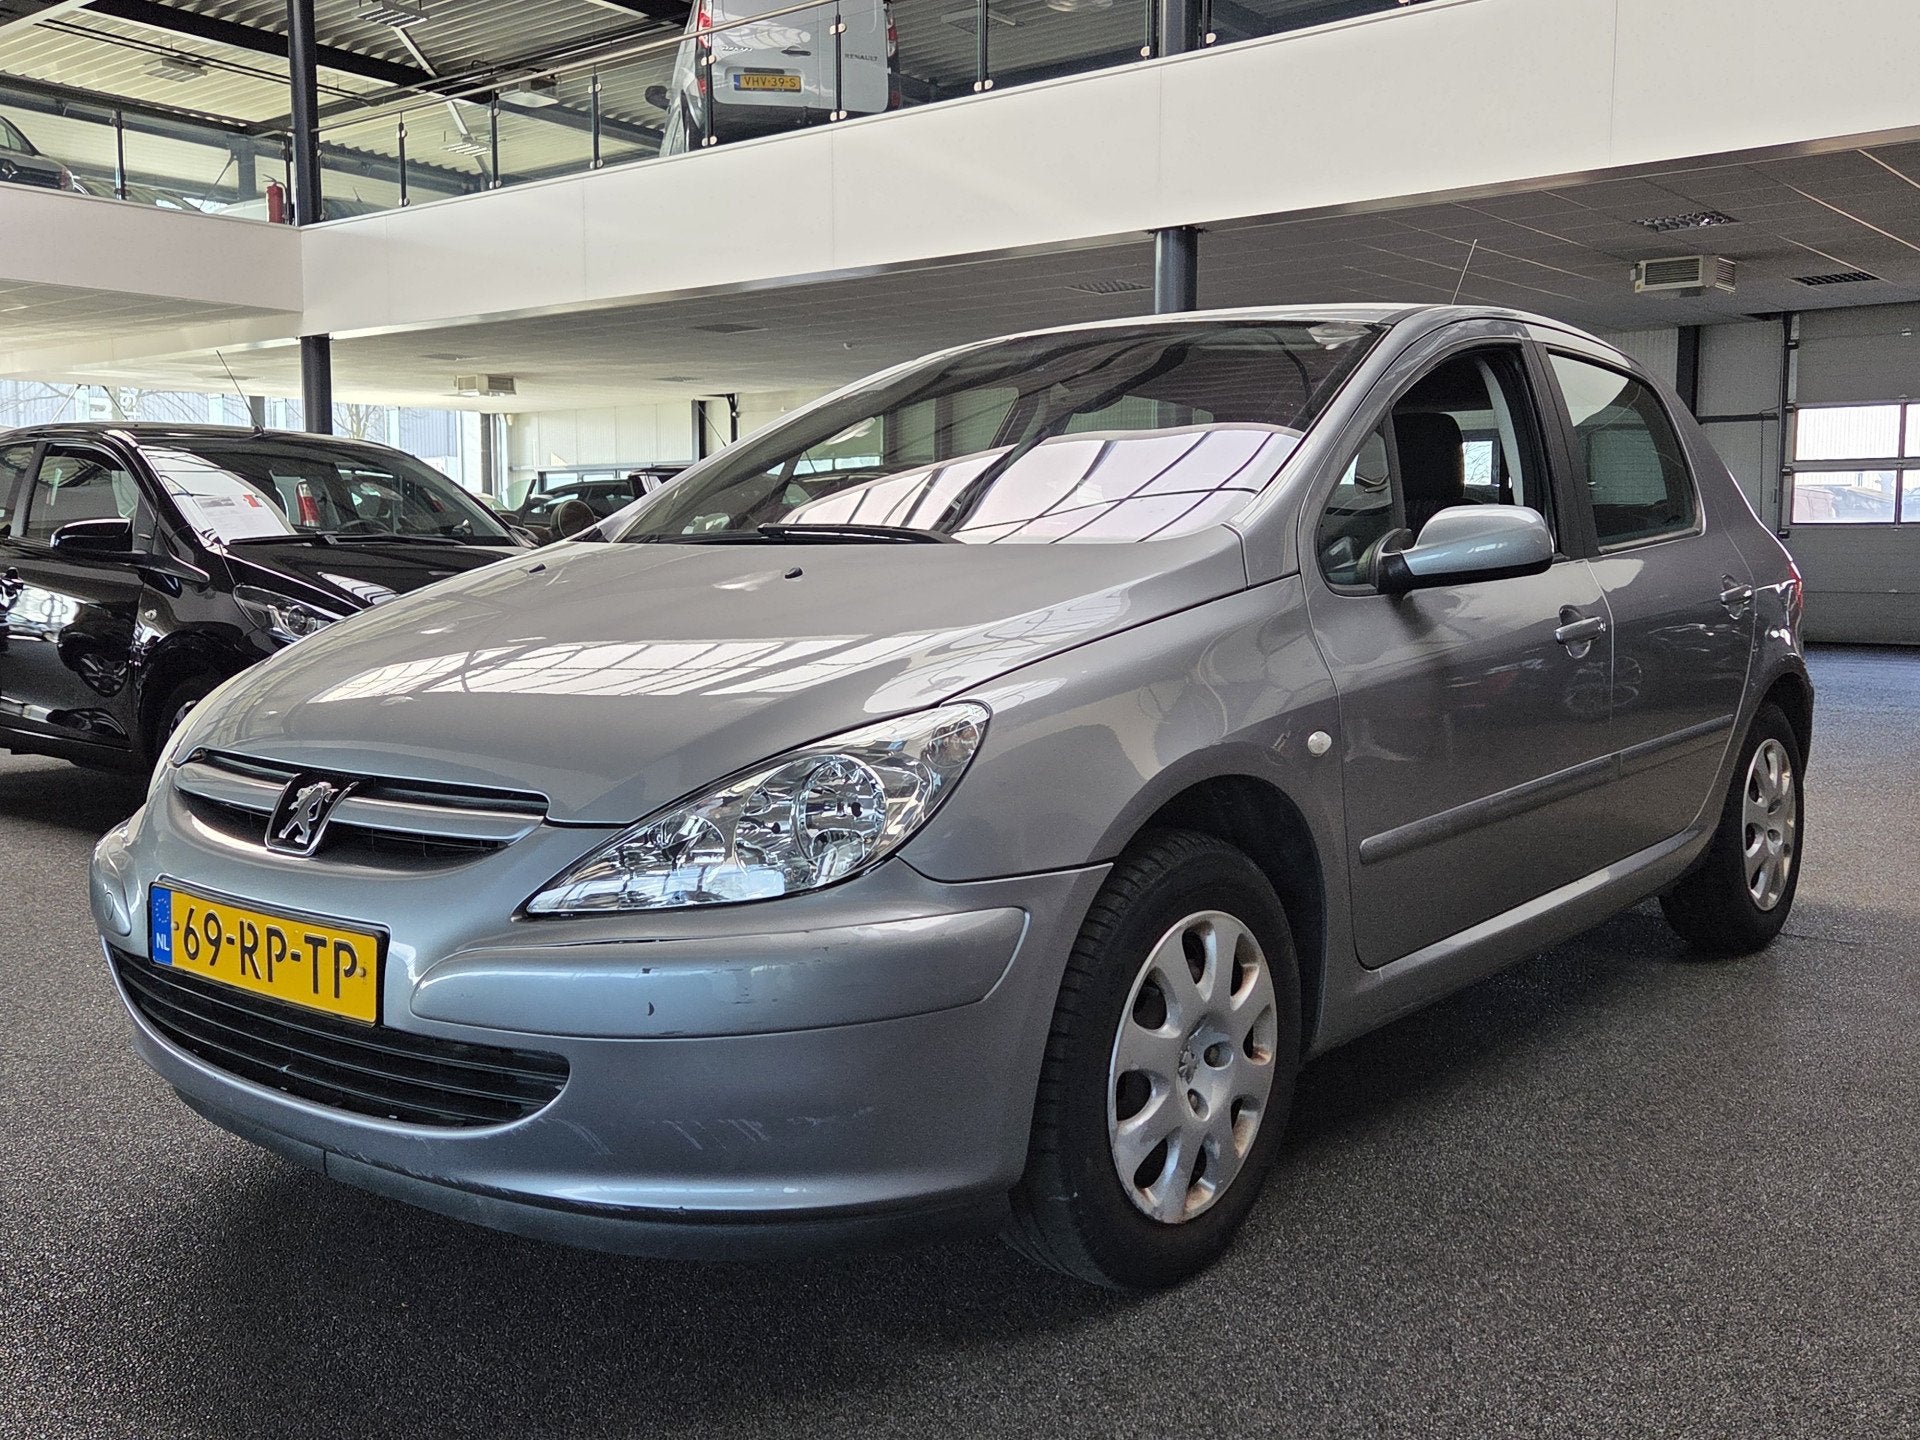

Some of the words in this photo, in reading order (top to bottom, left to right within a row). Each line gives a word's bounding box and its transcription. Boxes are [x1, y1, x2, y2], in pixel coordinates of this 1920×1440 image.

[743, 76, 796, 88] VHV-39-S
[156, 932, 170, 952] NL
[183, 906, 358, 999] 69-RP-TP
